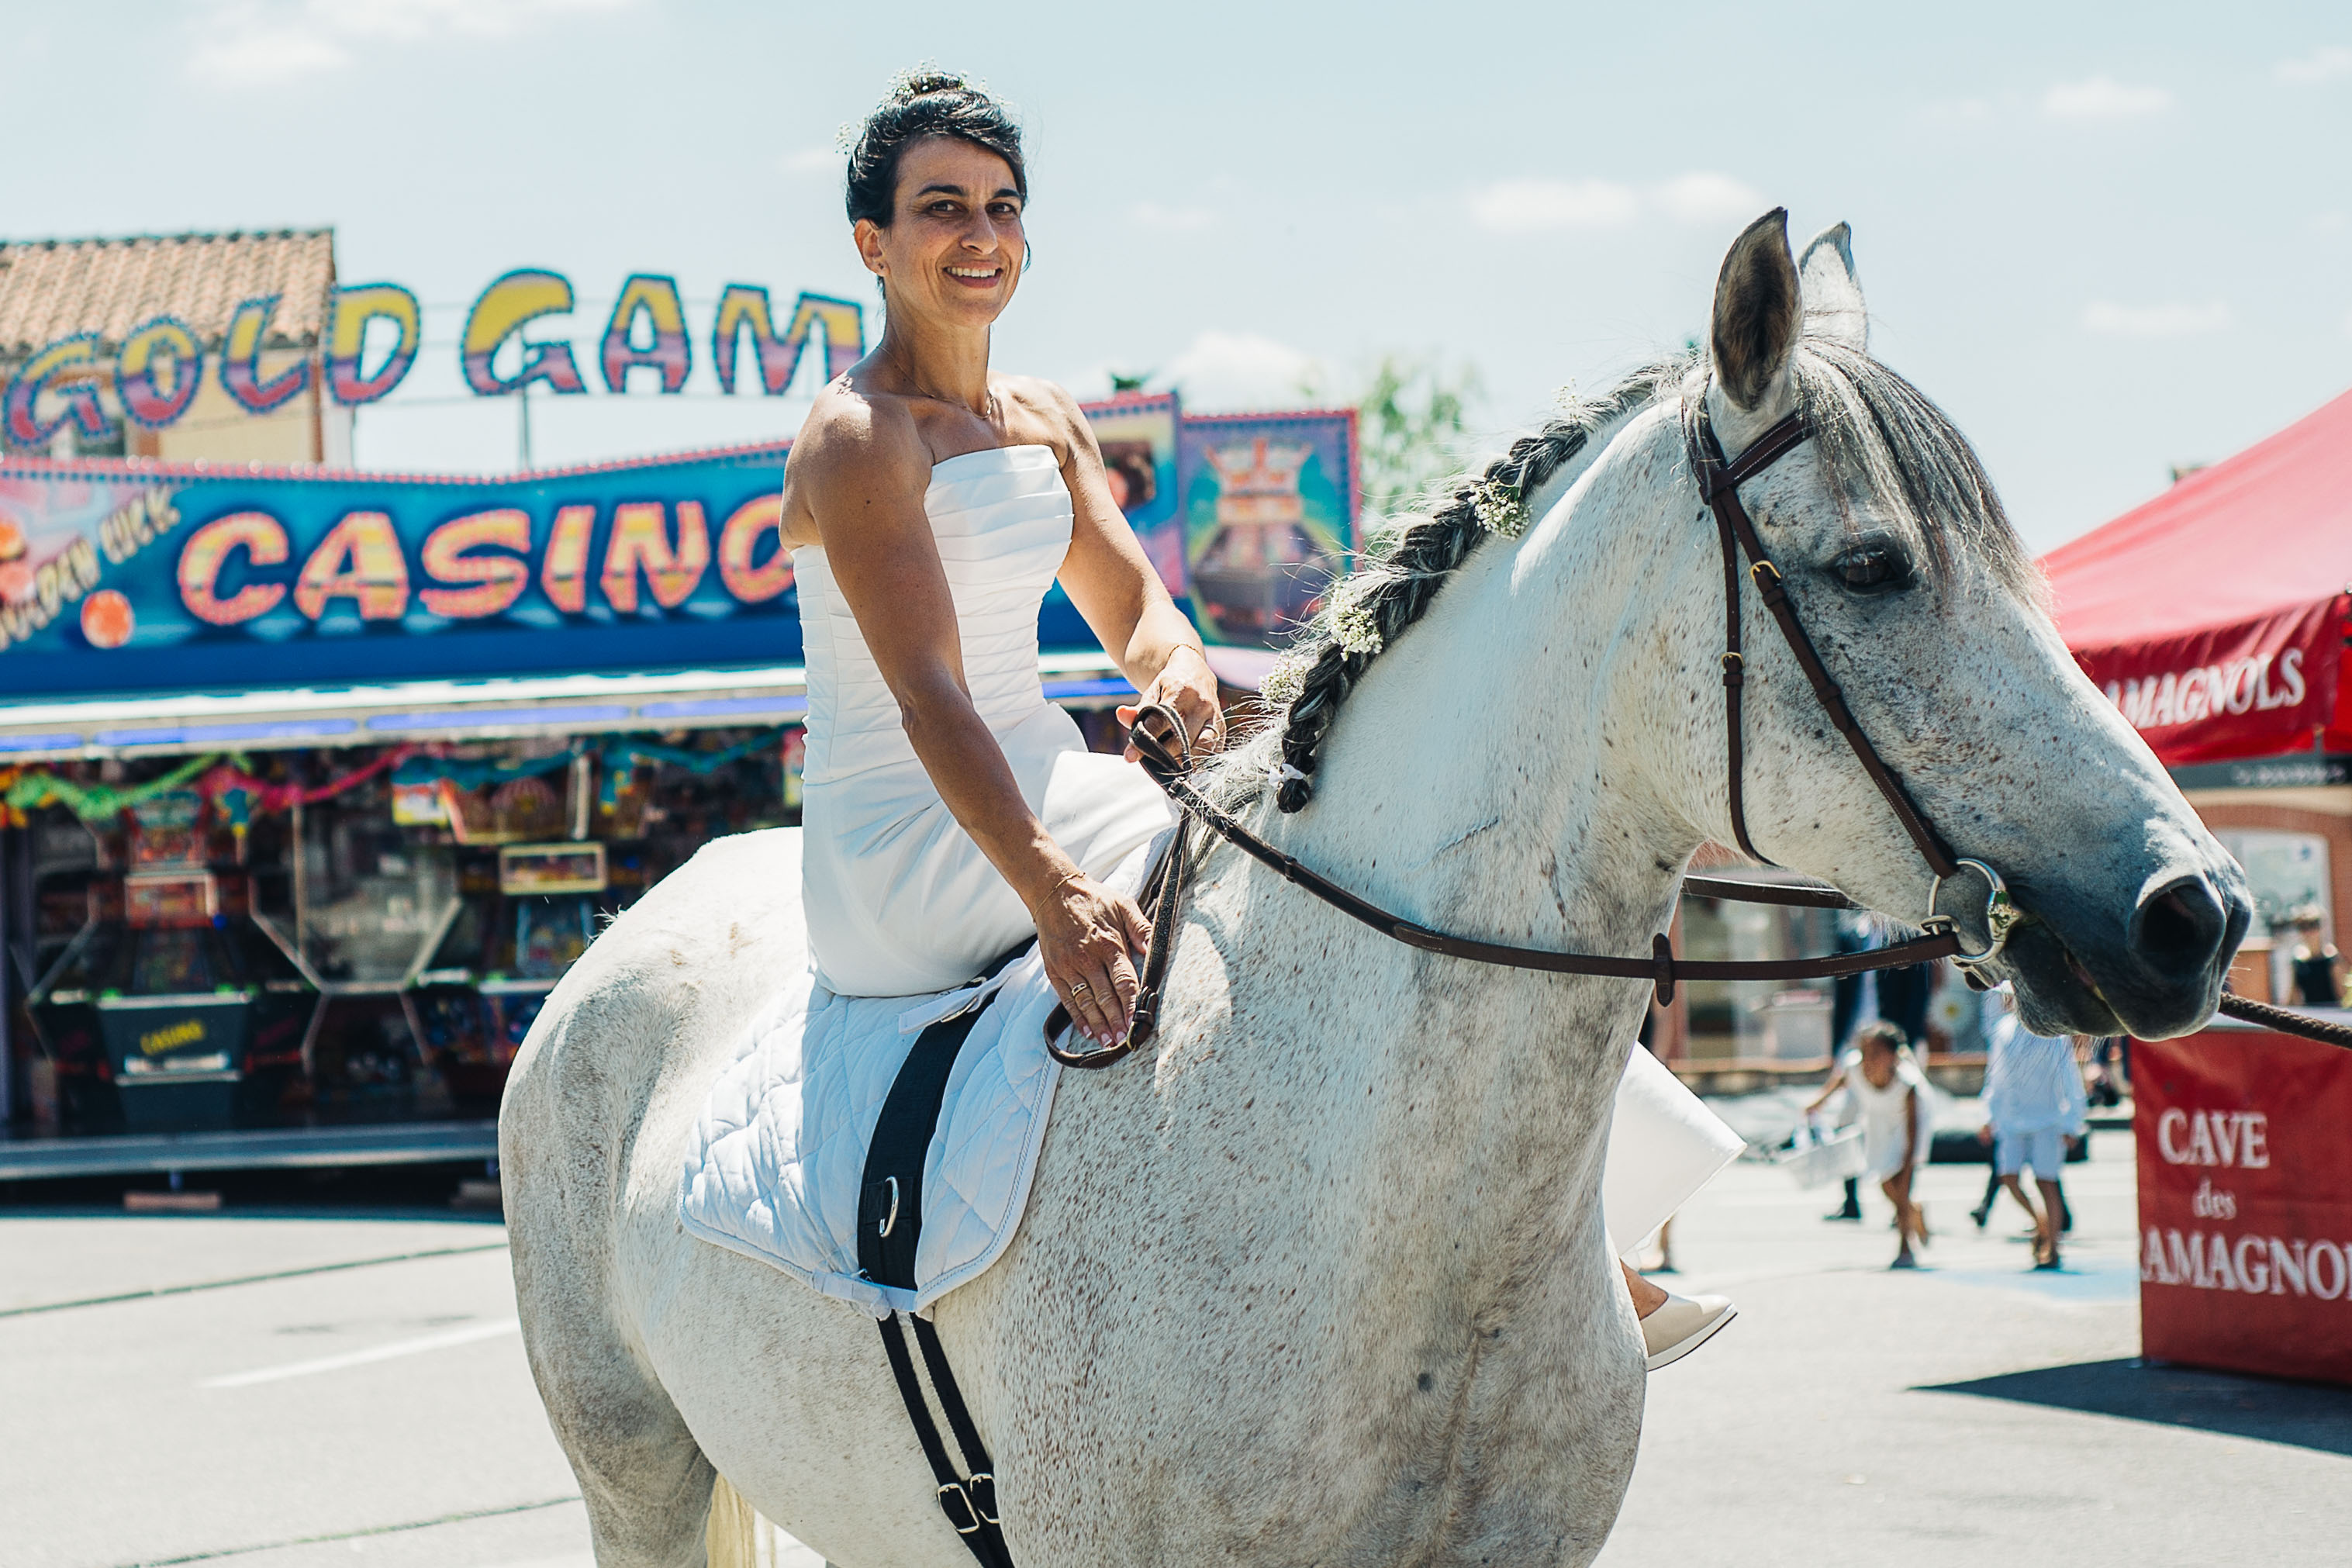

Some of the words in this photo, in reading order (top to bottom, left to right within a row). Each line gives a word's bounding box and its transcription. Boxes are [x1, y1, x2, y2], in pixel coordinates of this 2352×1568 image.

[2, 281, 421, 447] GOLD
[176, 493, 796, 625] CASINO
[2157, 1107, 2271, 1169] CAVE
[2191, 1175, 2238, 1221] des
[2139, 1224, 2352, 1302] AMAGNO
